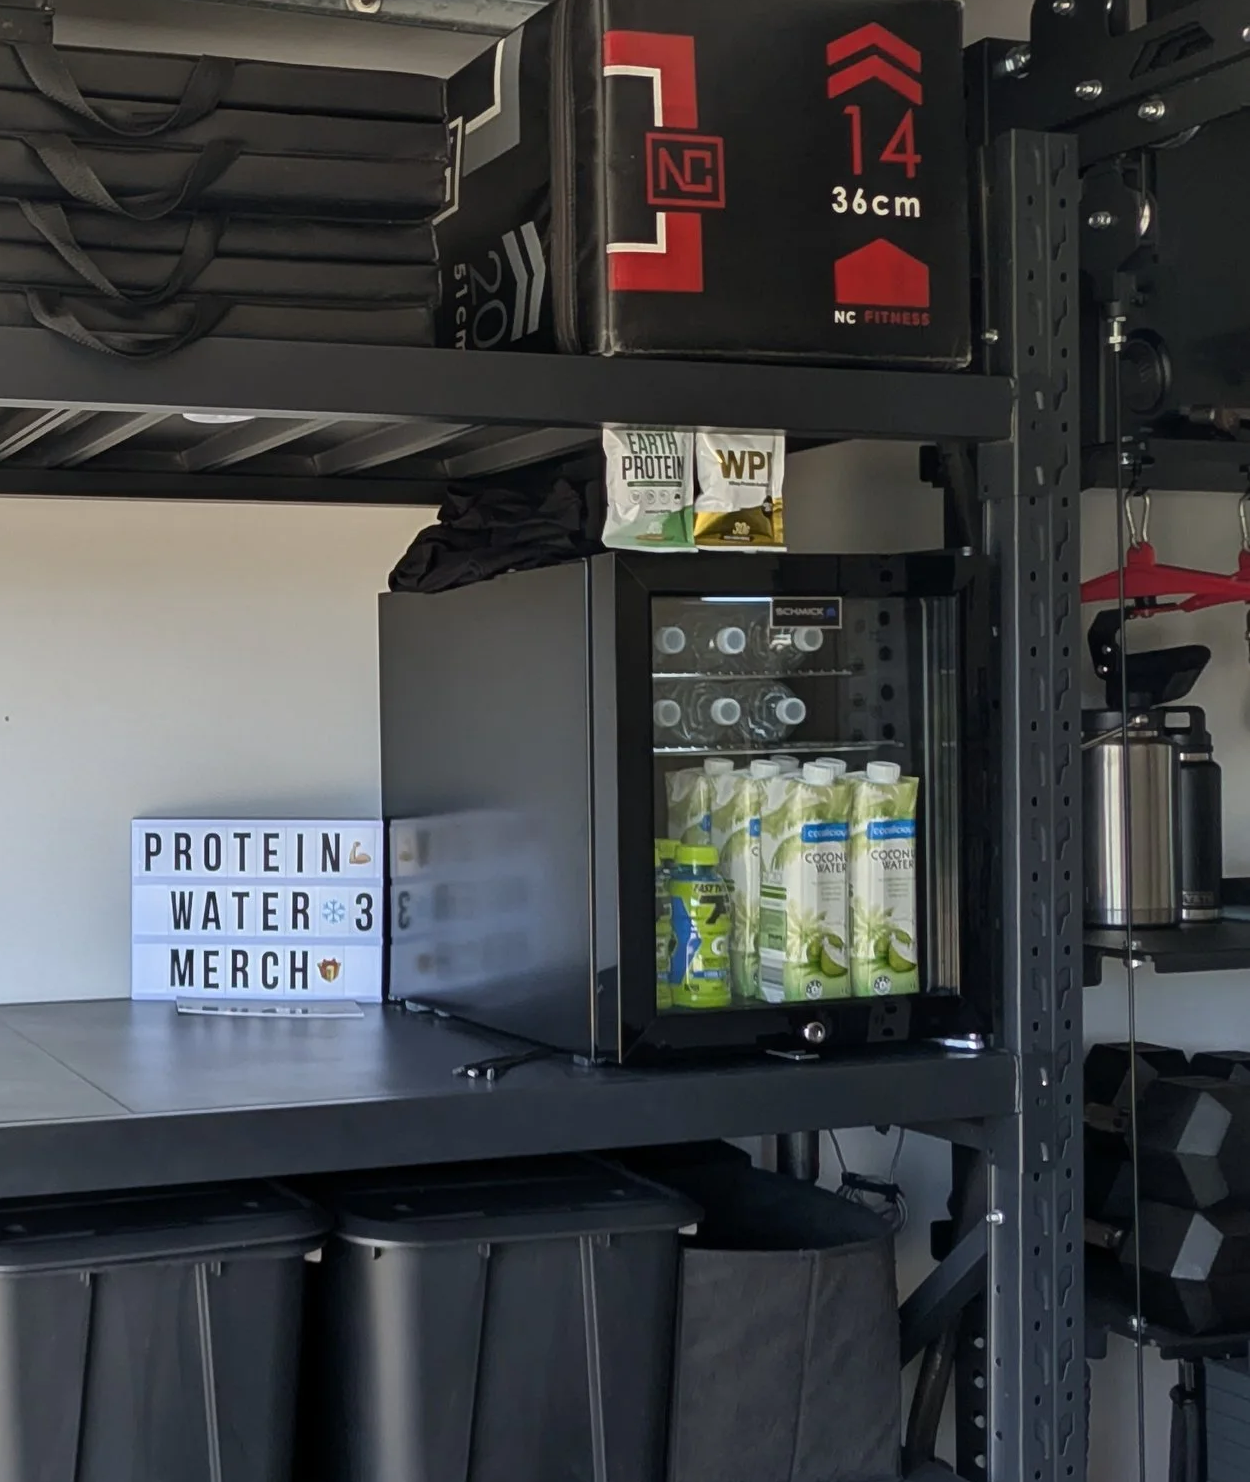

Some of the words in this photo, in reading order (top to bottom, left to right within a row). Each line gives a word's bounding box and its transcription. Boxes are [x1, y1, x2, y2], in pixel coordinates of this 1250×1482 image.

[843, 104, 922, 179] 14
[658, 147, 712, 193] NC
[831, 186, 921, 218] 36cm
[469, 250, 508, 349] 20
[834, 310, 856, 324] NC
[864, 310, 930, 326] FITNESS
[626, 432, 679, 455] EARTH
[621, 455, 685, 480] PROTEIN
[715, 449, 773, 481] WPI
[775, 607, 824, 616] SCHMICK
[143, 832, 341, 874] PROTEIN
[170, 890, 311, 932] WATER
[354, 892, 374, 932] 3
[169, 949, 310, 990] MERCH
